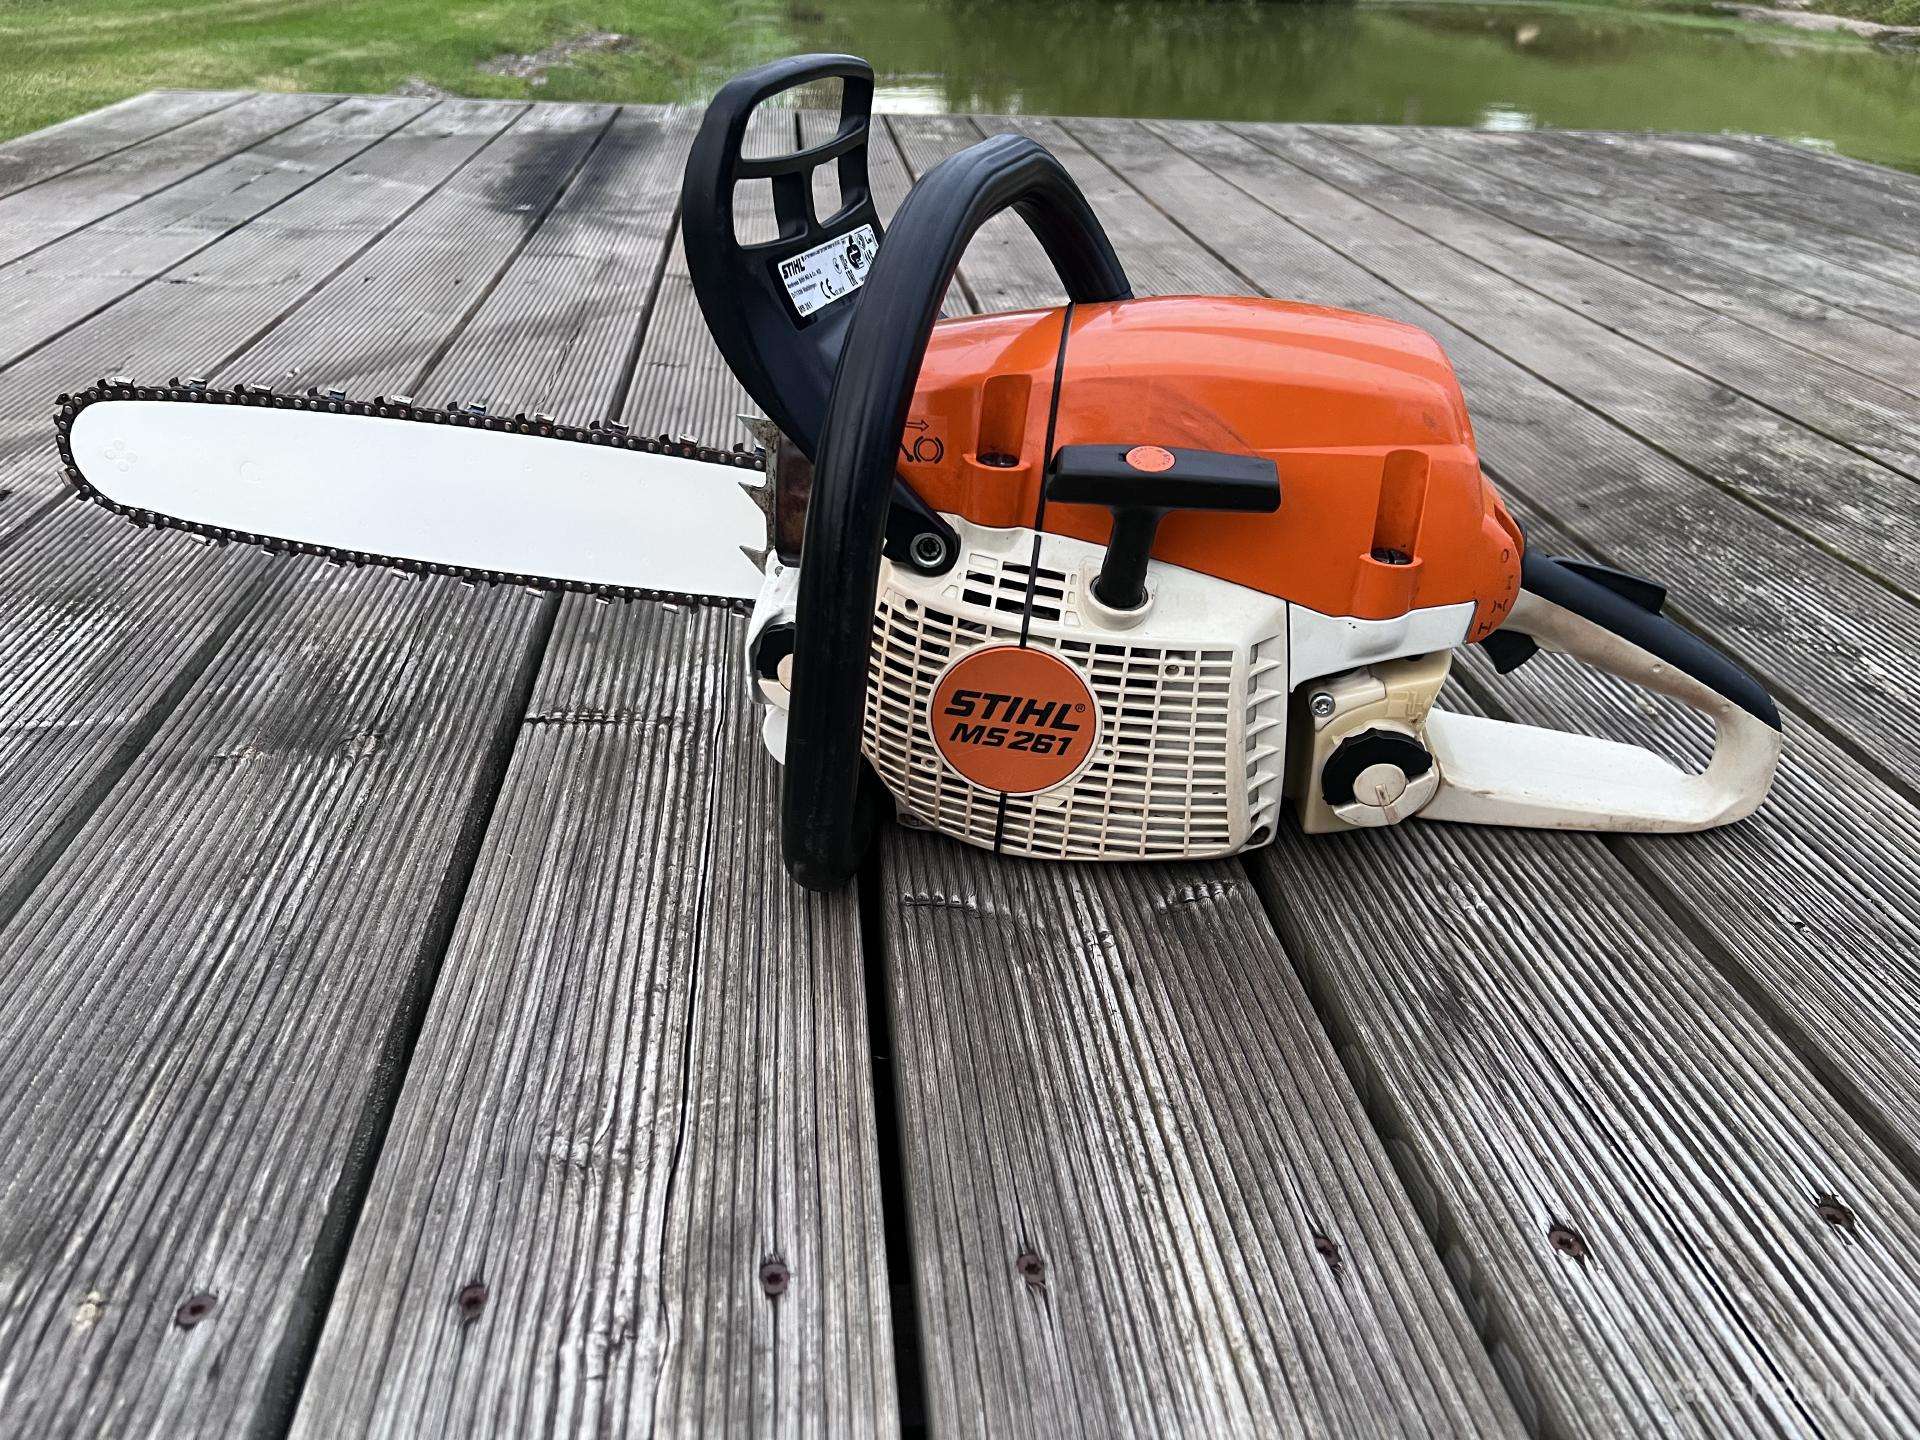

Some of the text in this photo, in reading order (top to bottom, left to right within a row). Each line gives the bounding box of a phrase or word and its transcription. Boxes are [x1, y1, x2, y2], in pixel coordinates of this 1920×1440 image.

[782, 258, 805, 279] STIHL
[949, 723, 1073, 756] MS 261
